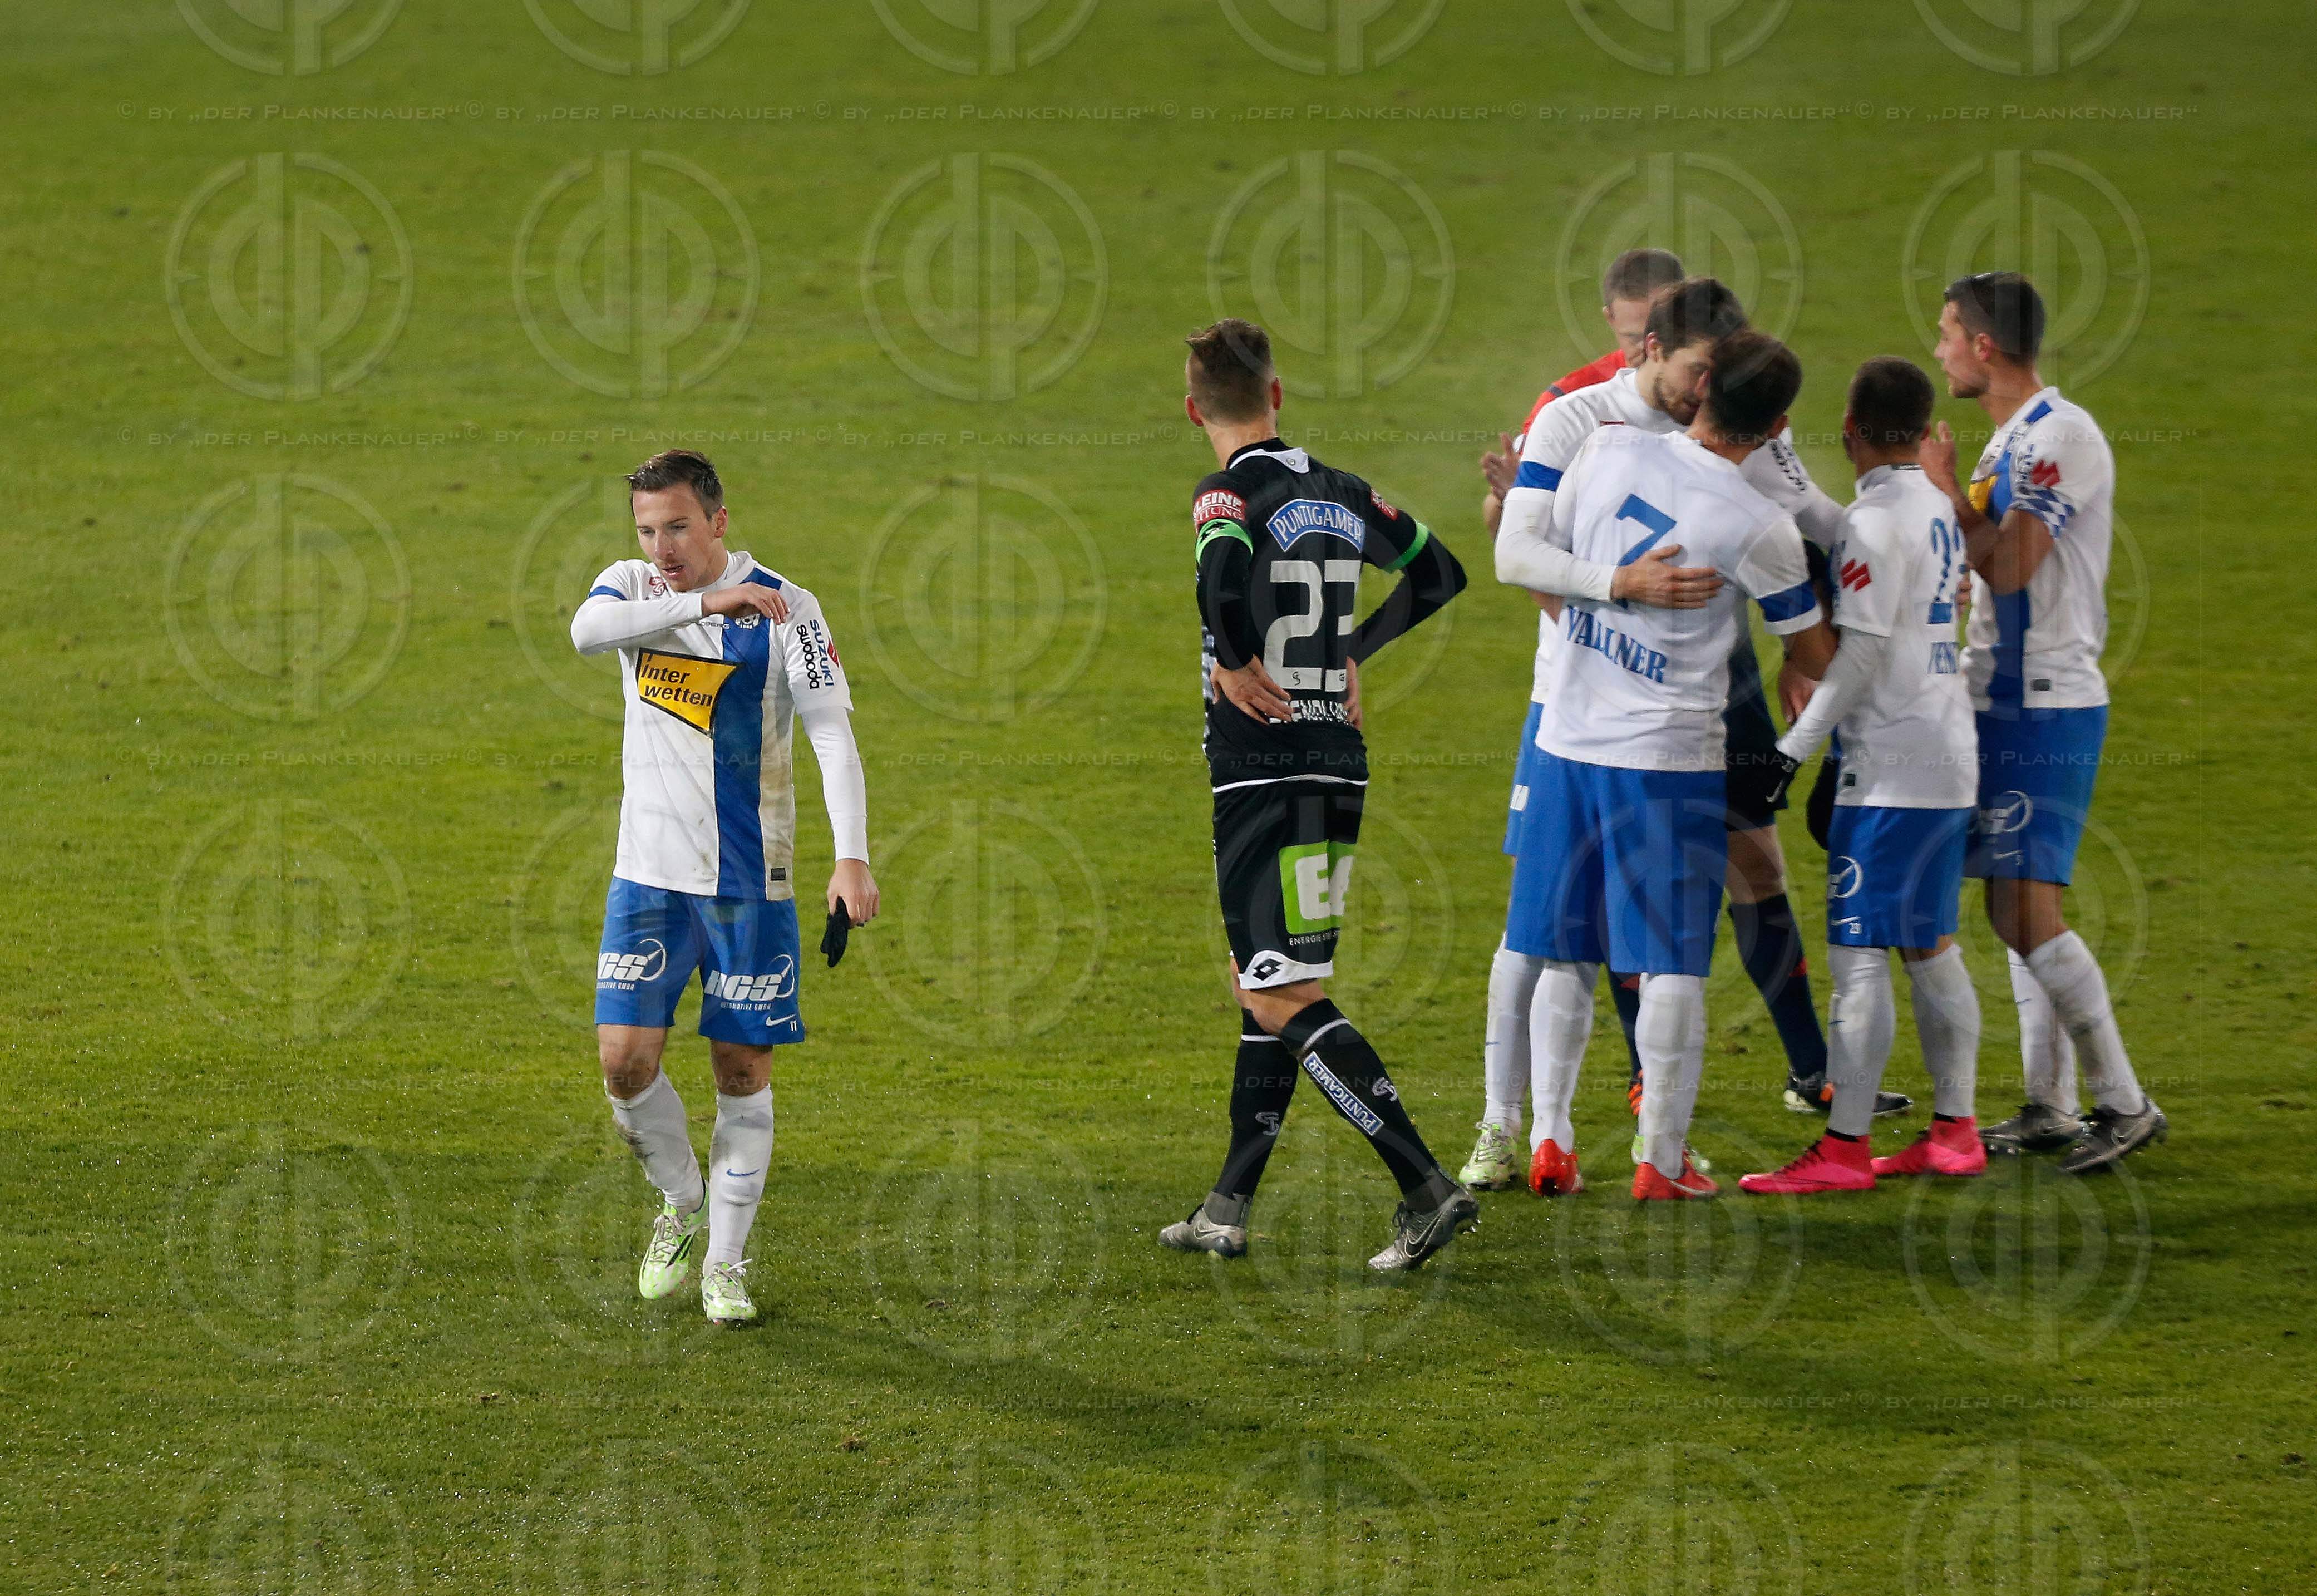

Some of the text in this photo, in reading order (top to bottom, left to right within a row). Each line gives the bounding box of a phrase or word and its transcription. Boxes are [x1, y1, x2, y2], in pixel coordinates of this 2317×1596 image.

[1194, 492, 1243, 513] LEINE
[1273, 505, 1362, 544] PUNTIGAMER
[1616, 494, 1677, 609] 7
[796, 624, 823, 689] swoboda
[809, 619, 835, 686] SUZUKI
[1264, 559, 1362, 693] 23
[644, 684, 713, 707] wetten
[1308, 1058, 1376, 1130] PUNTIGAMER
